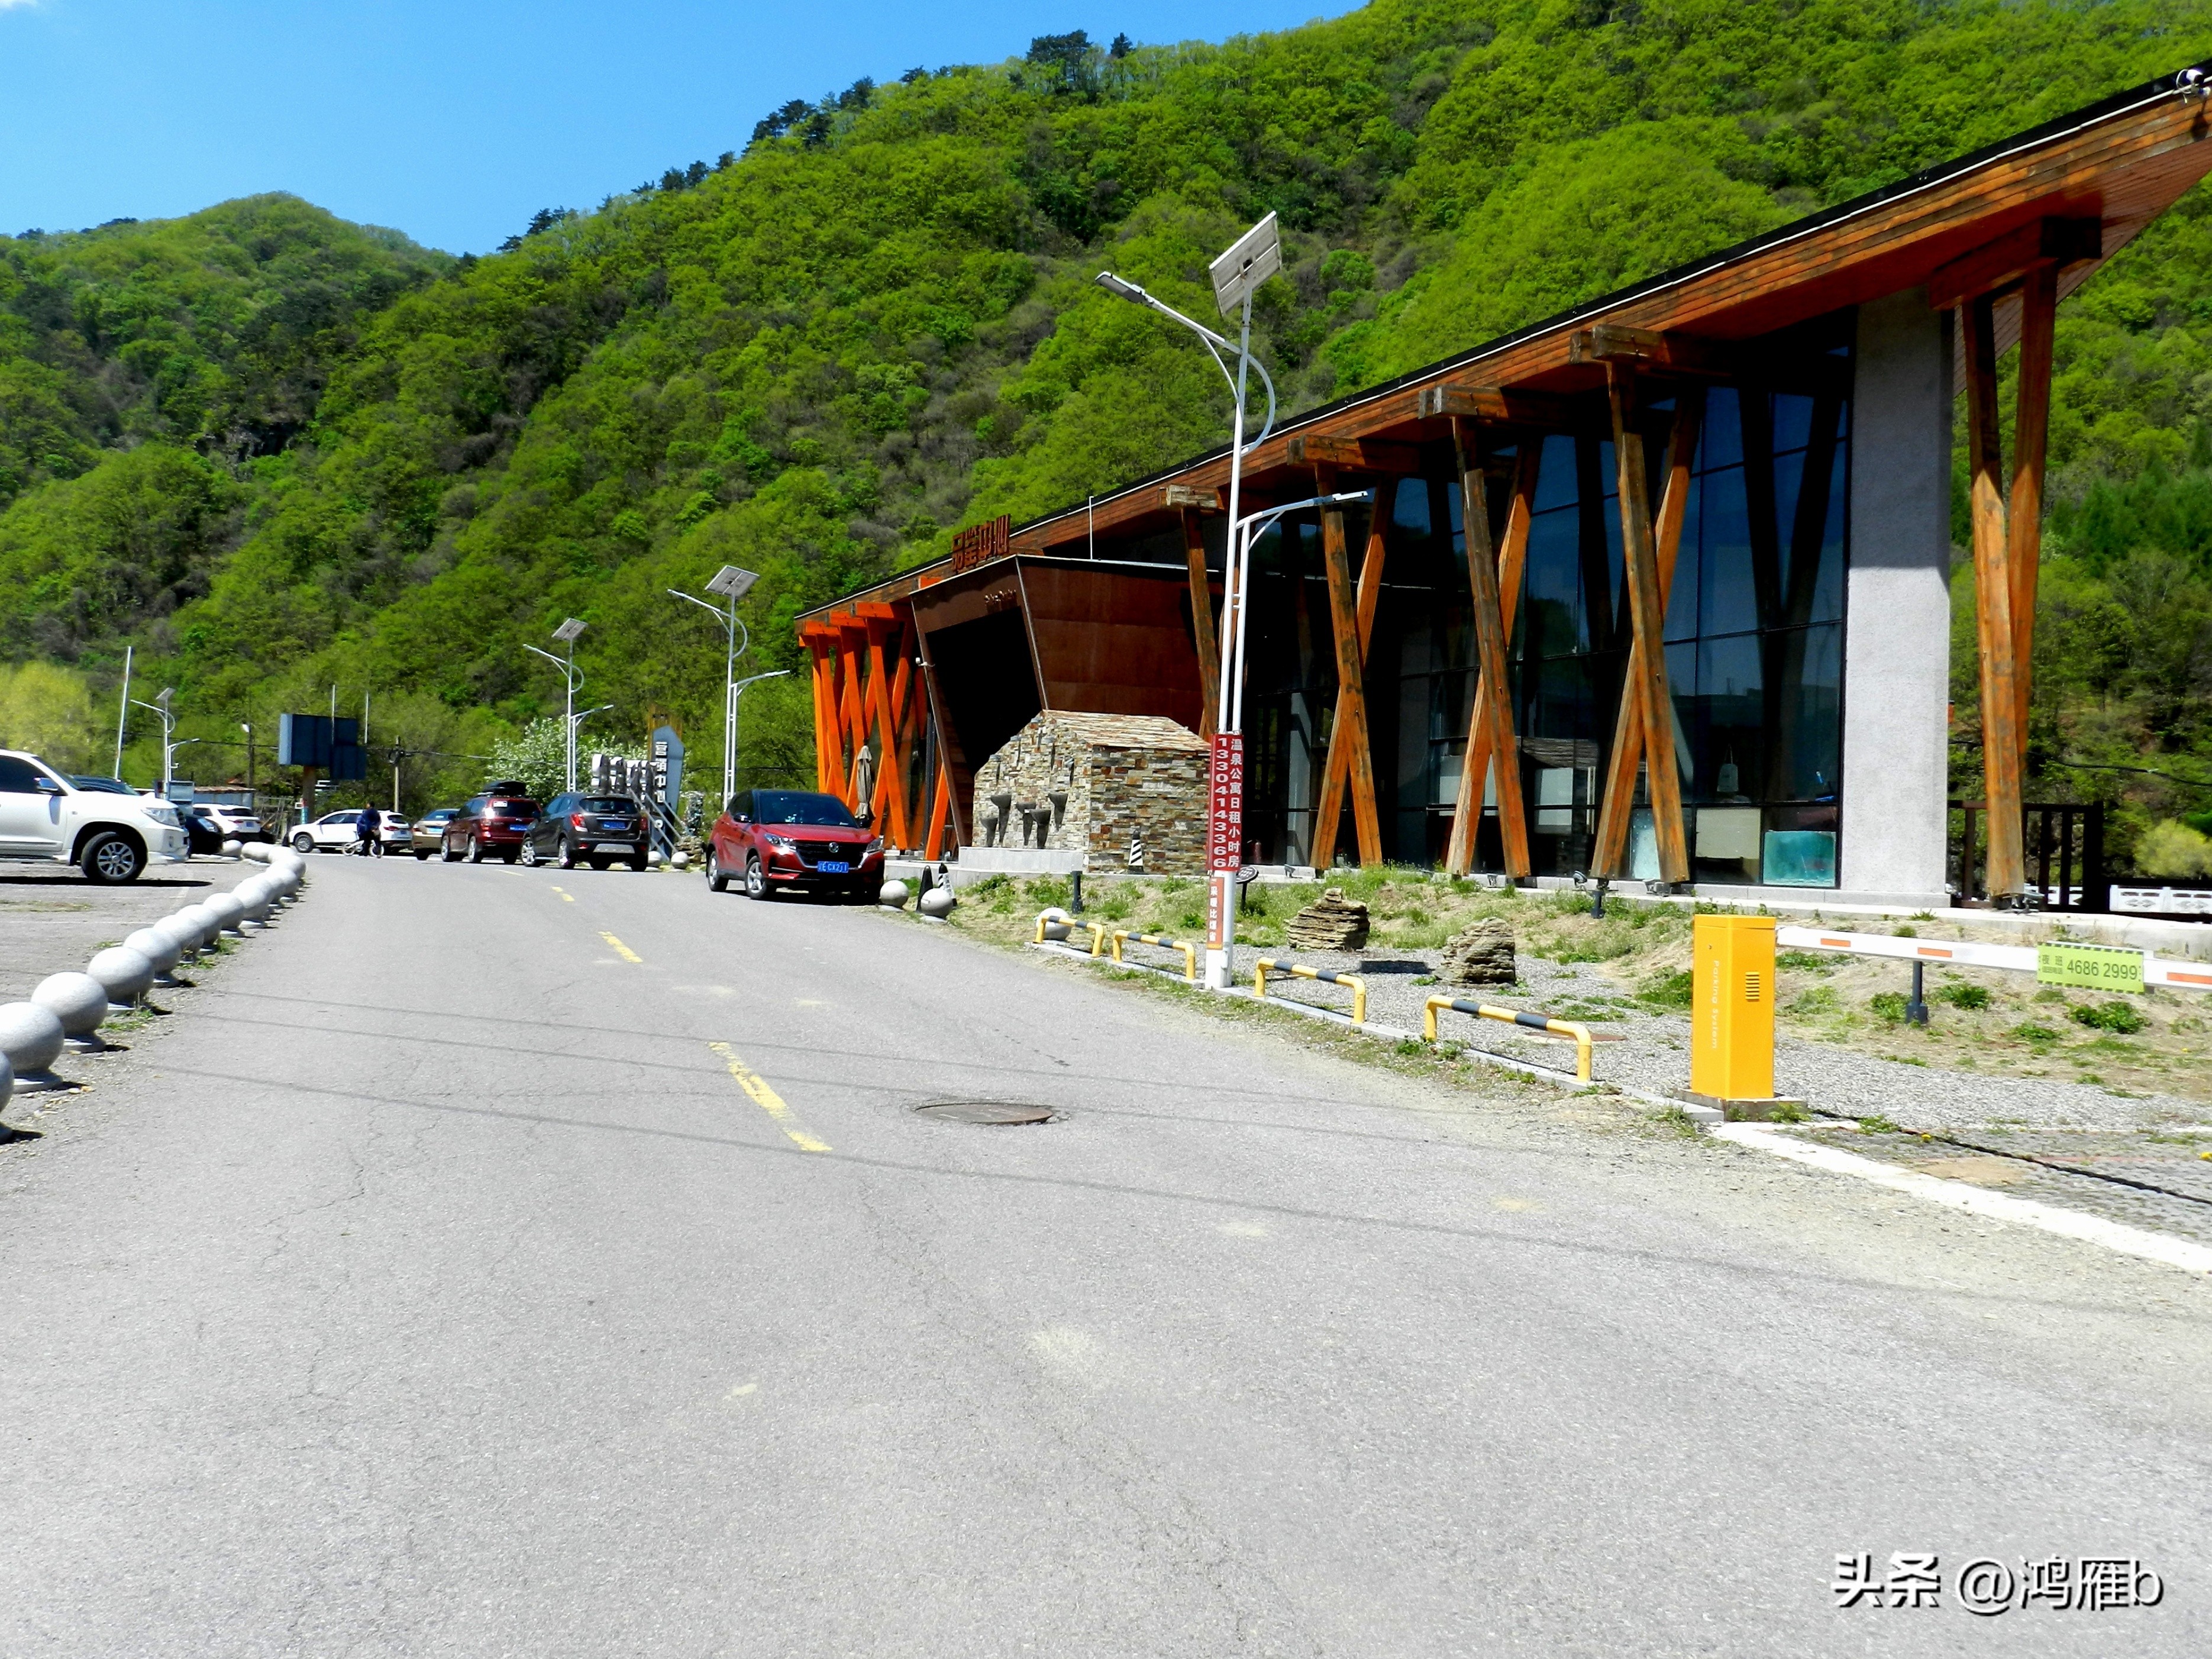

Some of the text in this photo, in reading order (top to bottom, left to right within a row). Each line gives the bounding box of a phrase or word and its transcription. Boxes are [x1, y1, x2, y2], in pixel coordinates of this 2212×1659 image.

[1213, 737, 1229, 868] 13304143366
[1228, 738, 1243, 867] 温泉公寓日租小时房
[1712, 960, 1720, 1004] Parking
[2067, 959, 2099, 976] 4686
[2103, 962, 2138, 980] 2999
